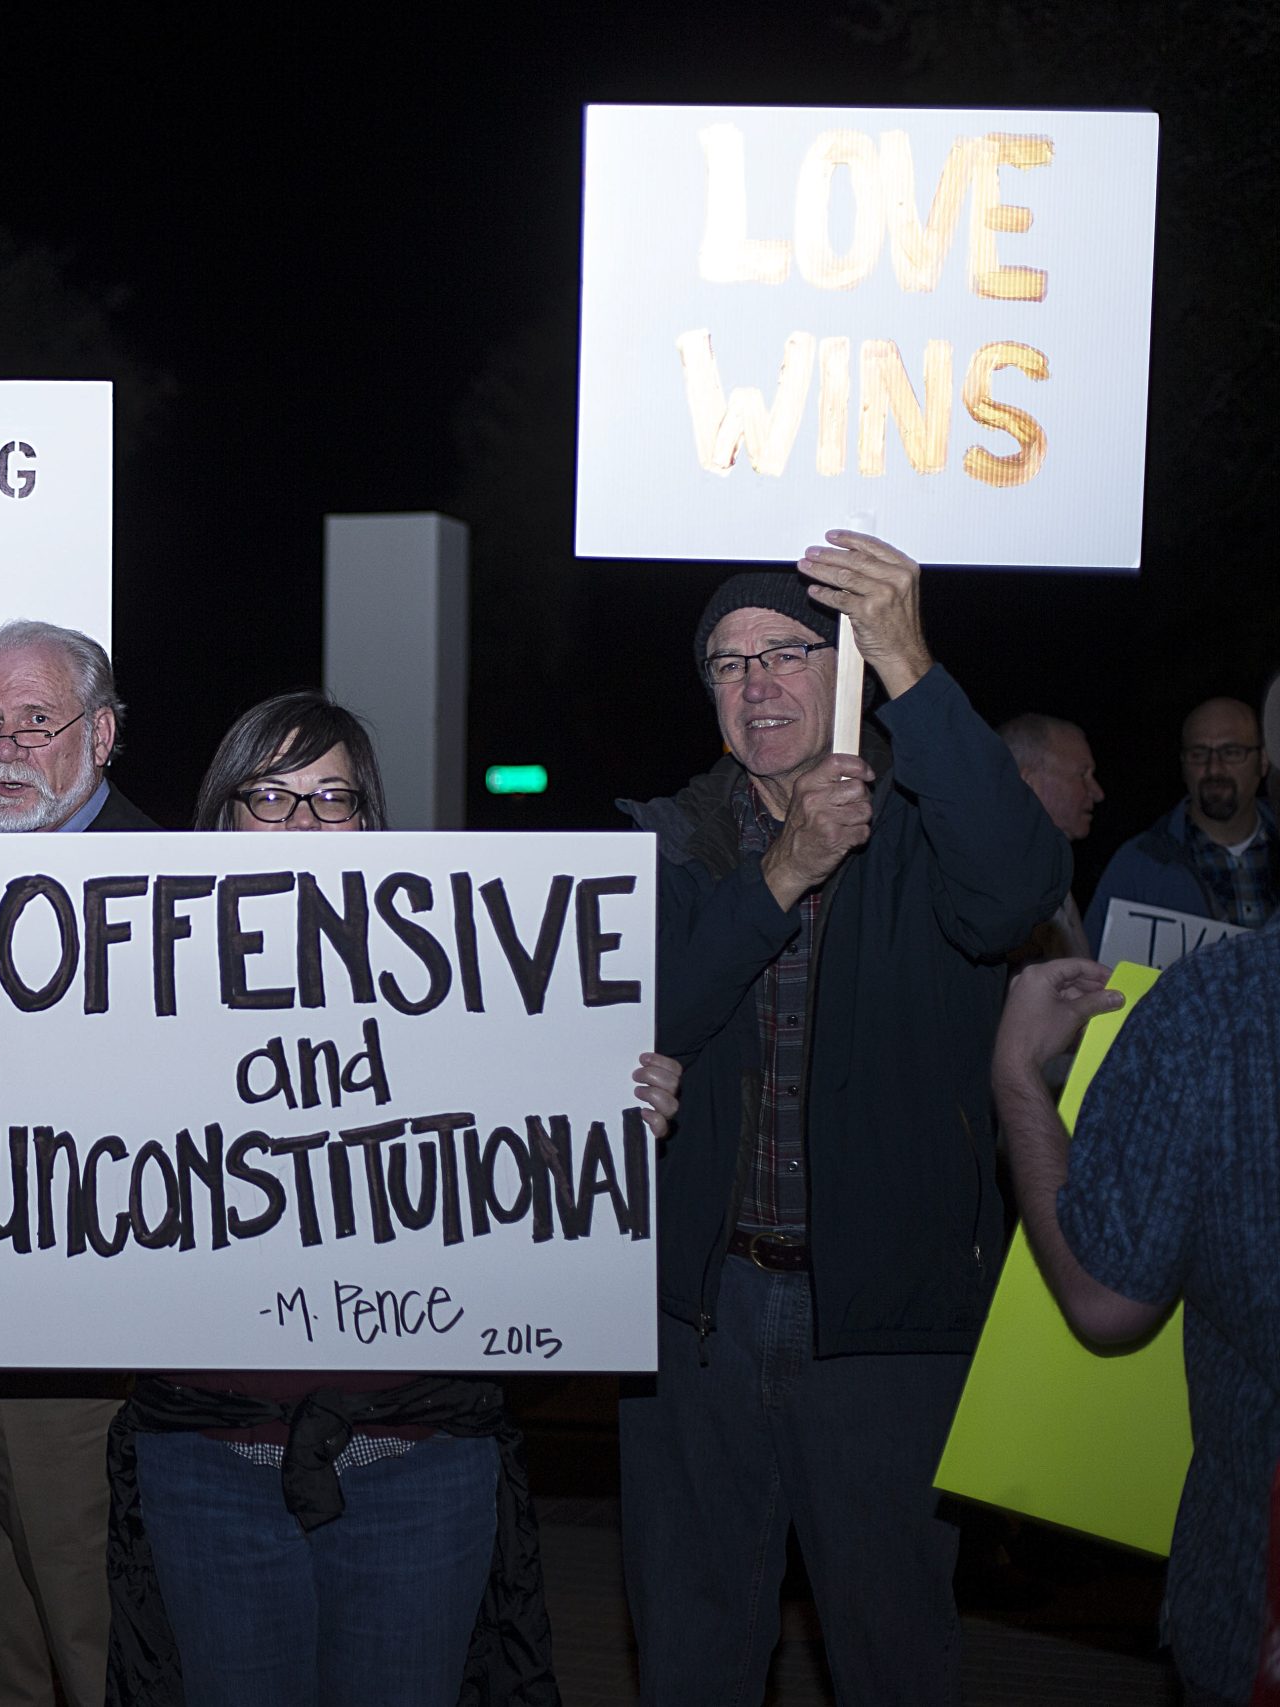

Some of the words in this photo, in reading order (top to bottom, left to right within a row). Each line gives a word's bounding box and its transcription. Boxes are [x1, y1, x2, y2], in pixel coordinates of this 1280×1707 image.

[698, 122, 1054, 302] LOVE
[676, 328, 1051, 488] WINS
[236, 1018, 391, 1110] and
[334, 1280, 464, 1344] Pence
[481, 1324, 562, 1358] 2015
